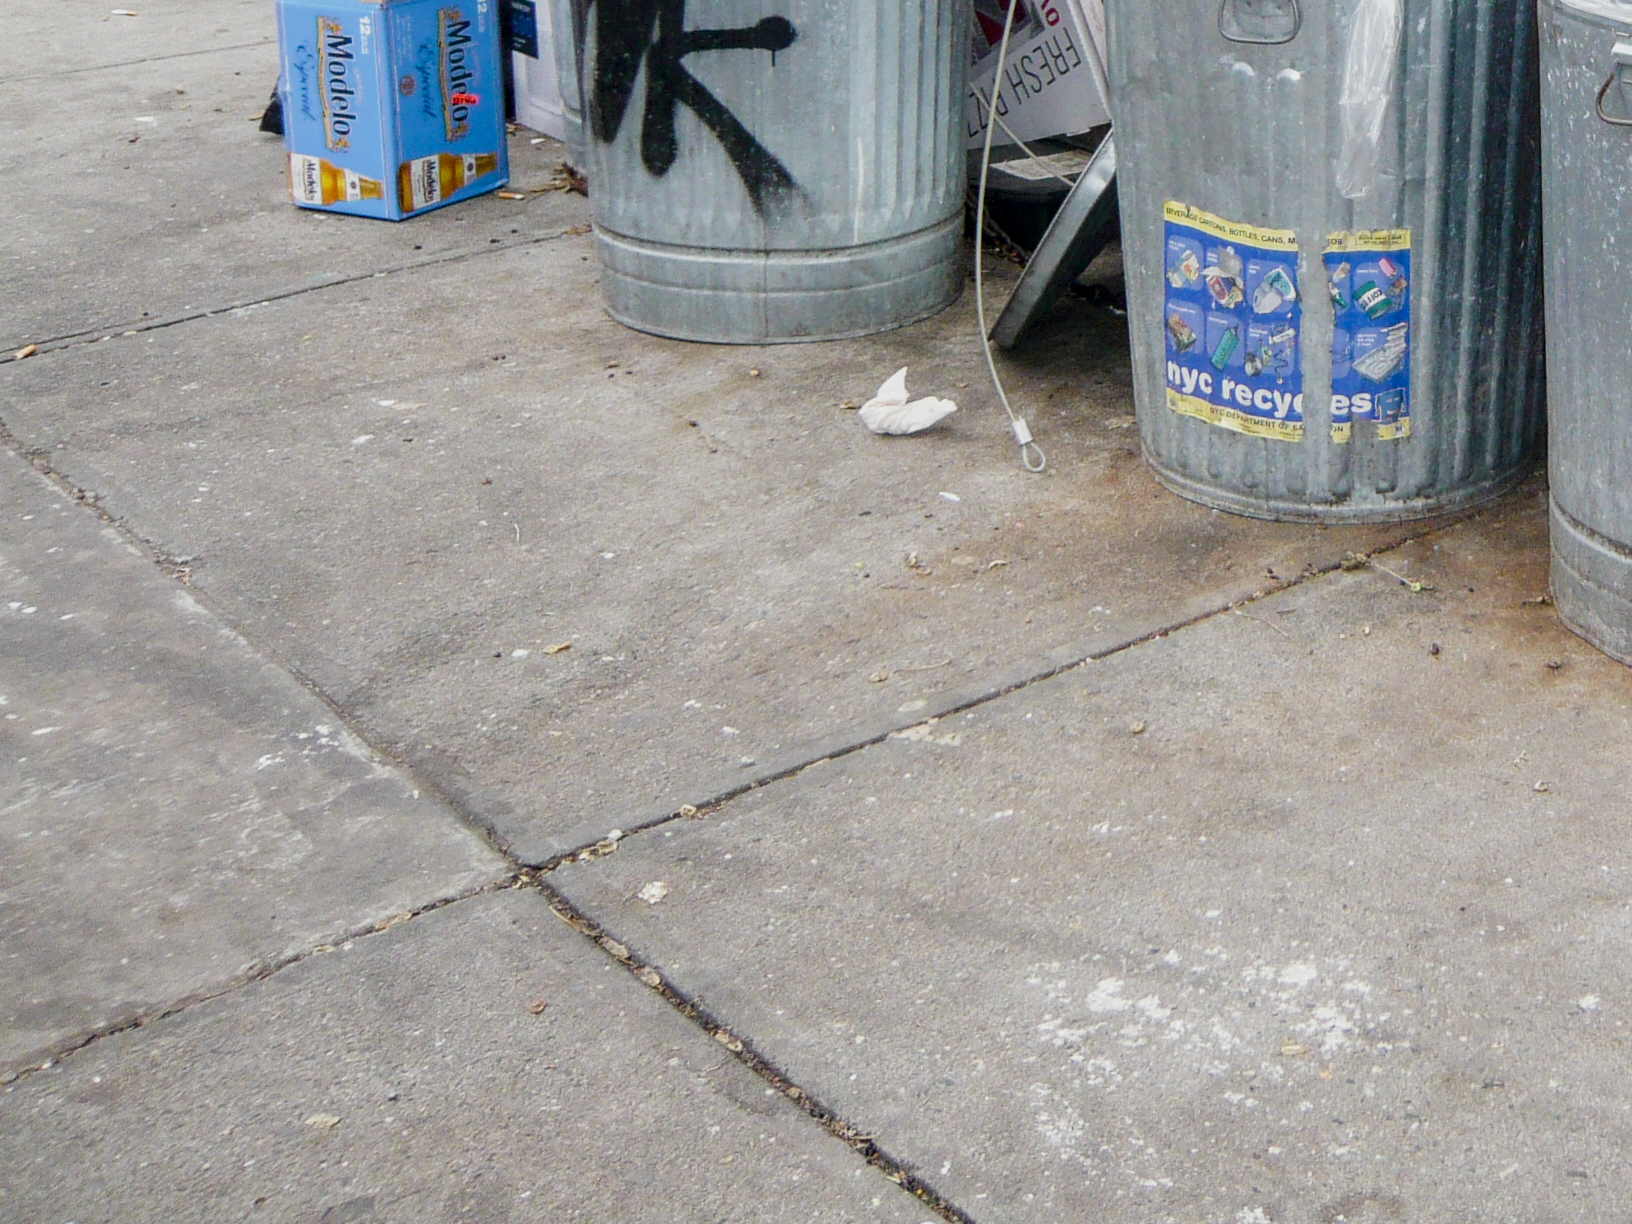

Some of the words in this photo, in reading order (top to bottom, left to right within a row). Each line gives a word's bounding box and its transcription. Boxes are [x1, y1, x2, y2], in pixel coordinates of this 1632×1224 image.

[359, 15, 371, 36] 12
[326, 34, 356, 136] Modelo
[447, 19, 473, 122] Modeo
[1005, 27, 1082, 105] FRESH
[1167, 360, 1213, 394] nyc
[1226, 411, 1276, 429] DEPARTMENT
